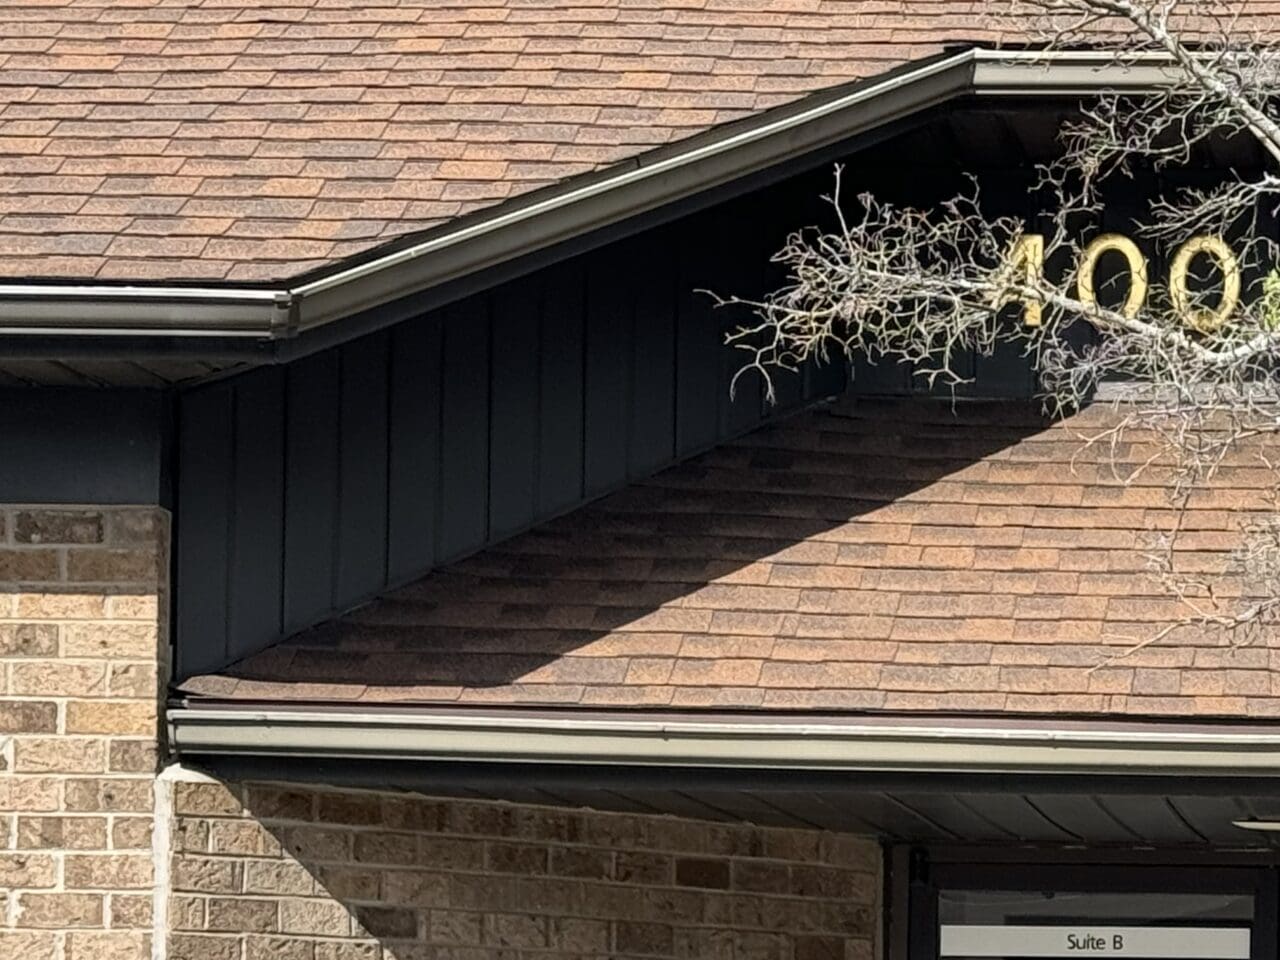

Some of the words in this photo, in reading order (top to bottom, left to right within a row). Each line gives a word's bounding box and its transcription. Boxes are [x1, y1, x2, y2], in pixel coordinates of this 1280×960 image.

[990, 232, 1241, 331] 400
[1067, 934, 1106, 950] Suite
[1113, 935, 1123, 950] B
